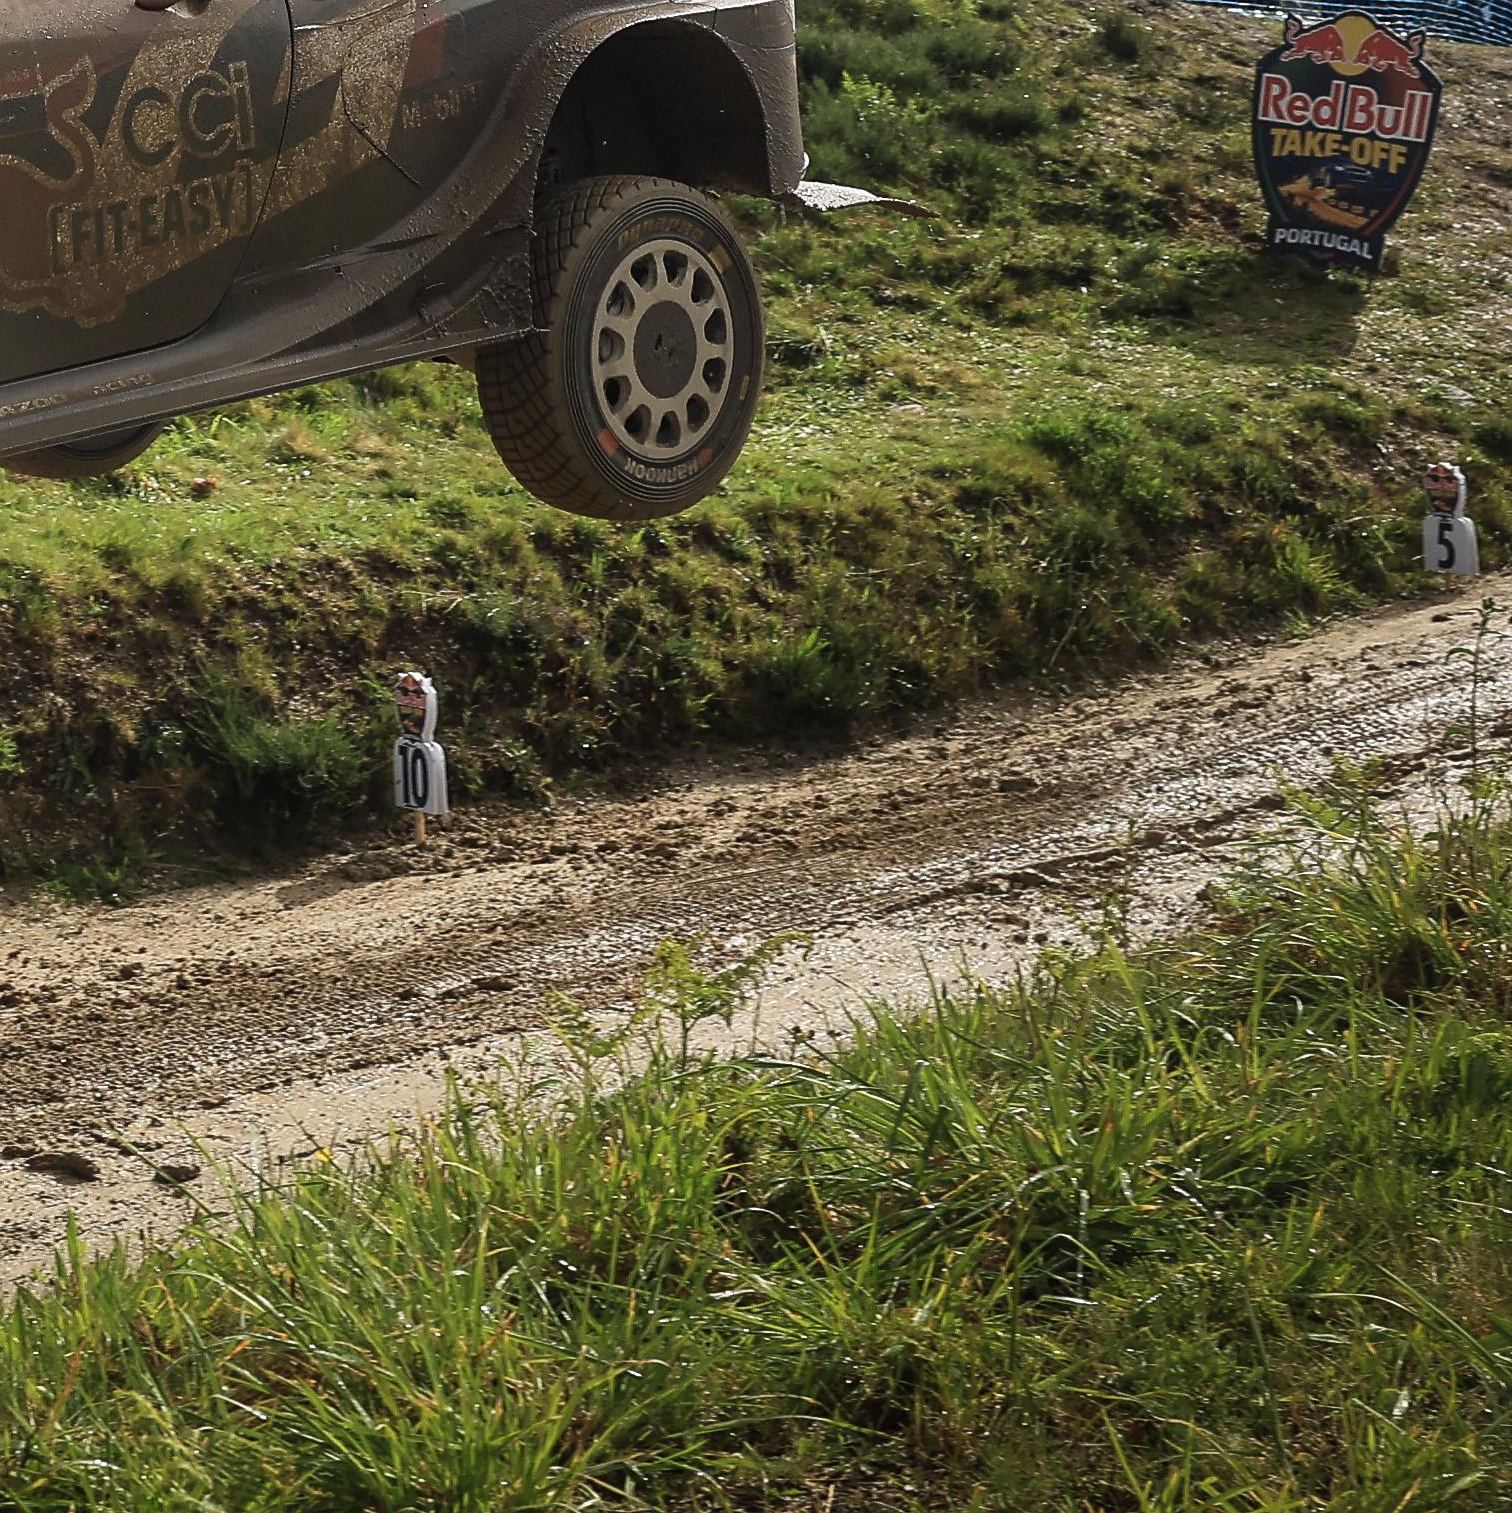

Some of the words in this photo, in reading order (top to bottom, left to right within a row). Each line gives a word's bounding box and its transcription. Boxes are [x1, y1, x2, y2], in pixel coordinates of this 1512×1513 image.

[1269, 128, 1407, 175] TAKE-OFF
[1274, 227, 1374, 261] PORTUGAL
[1437, 521, 1456, 569] 5
[398, 745, 429, 807] 10
